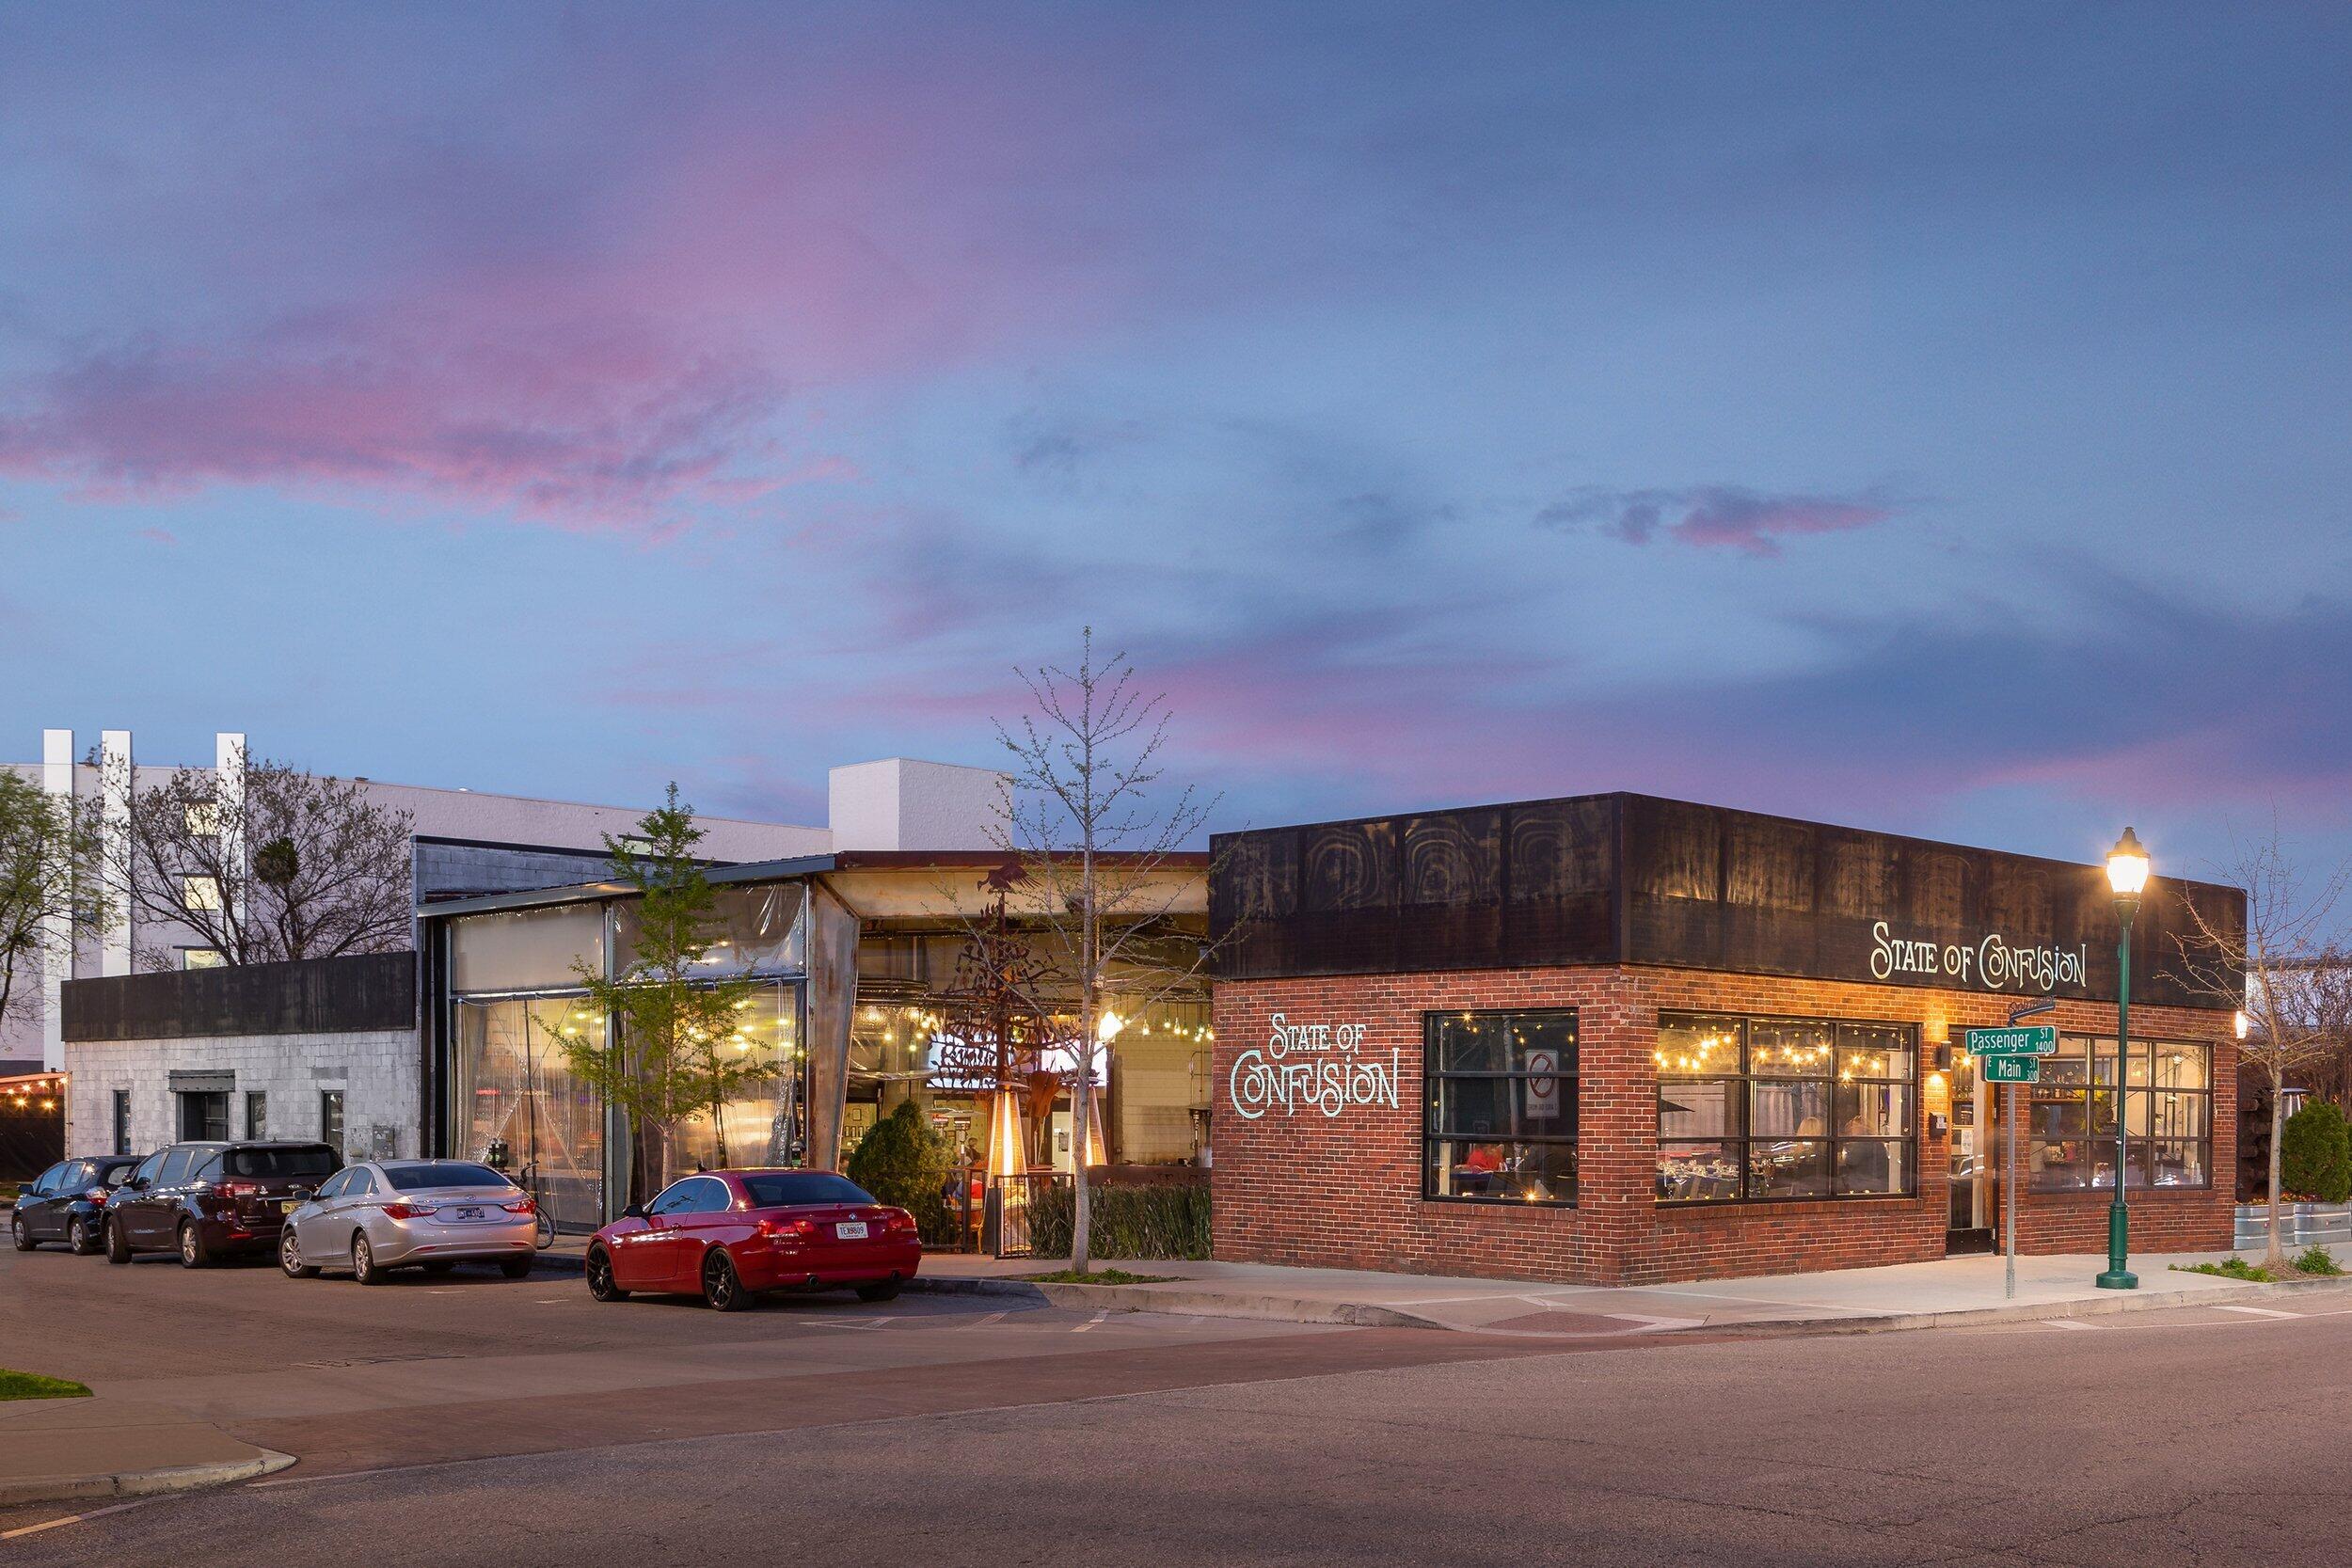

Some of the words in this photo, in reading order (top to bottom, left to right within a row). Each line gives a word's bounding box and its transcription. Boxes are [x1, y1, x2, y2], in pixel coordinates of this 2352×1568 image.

[1870, 921, 1938, 980] STATE
[1944, 944, 1975, 983] OF
[1269, 1013, 1331, 1060] STATE
[1336, 1023, 1367, 1055] OF
[1970, 1031, 2030, 1053] Passenger
[2040, 1027, 2049, 1039] ST
[2035, 1040, 2054, 1052] 1400
[1988, 1056, 1993, 1068] E
[1998, 1058, 2022, 1078] Main
[2028, 1057, 2036, 1069] ST
